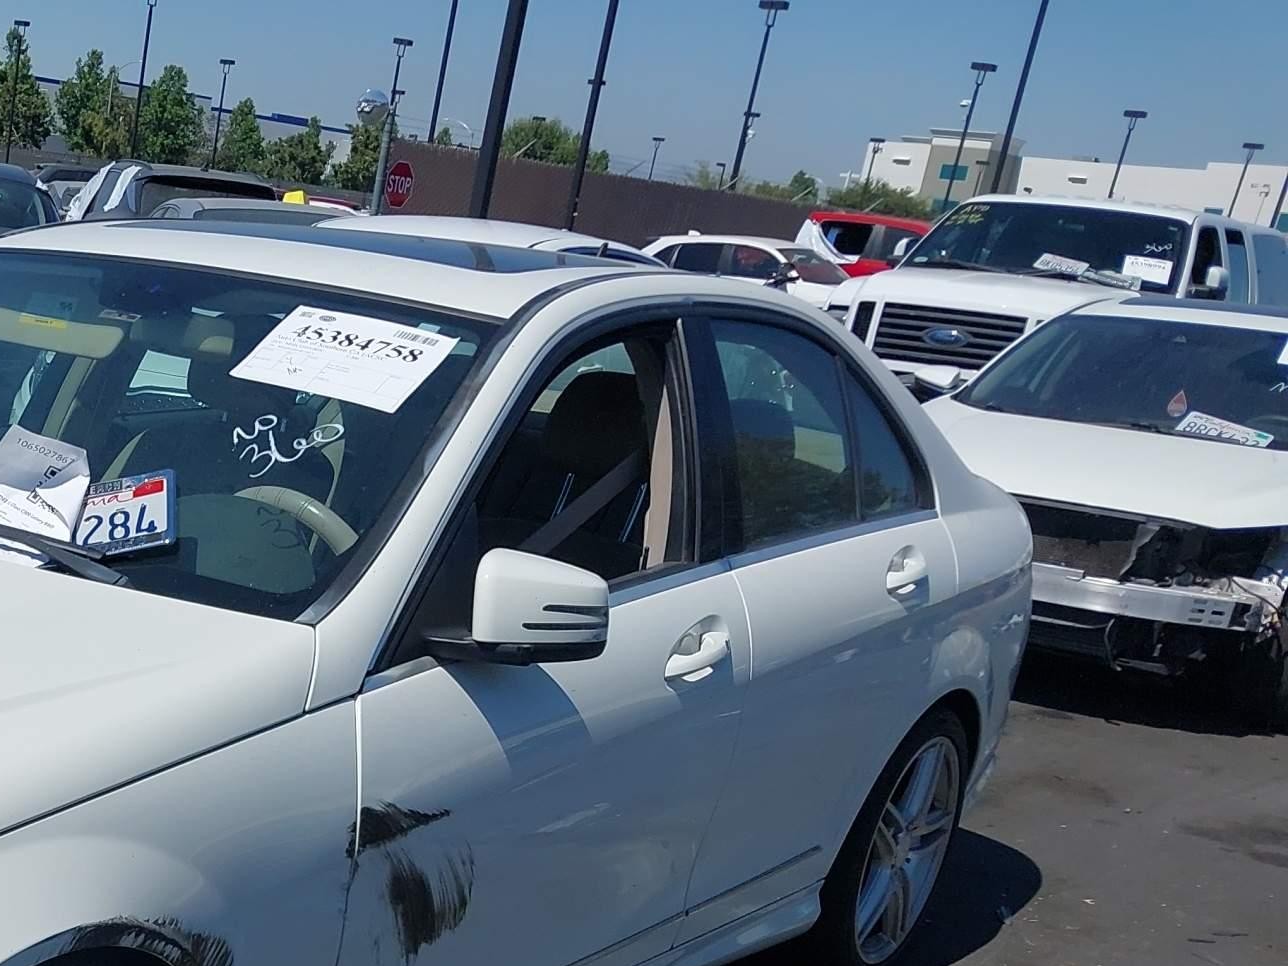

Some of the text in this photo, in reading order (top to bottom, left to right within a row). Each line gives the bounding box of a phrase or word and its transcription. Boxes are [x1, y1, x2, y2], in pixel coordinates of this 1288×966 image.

[387, 175, 412, 194] STOP
[289, 324, 424, 363] 45384758
[82, 503, 158, 546] 284
